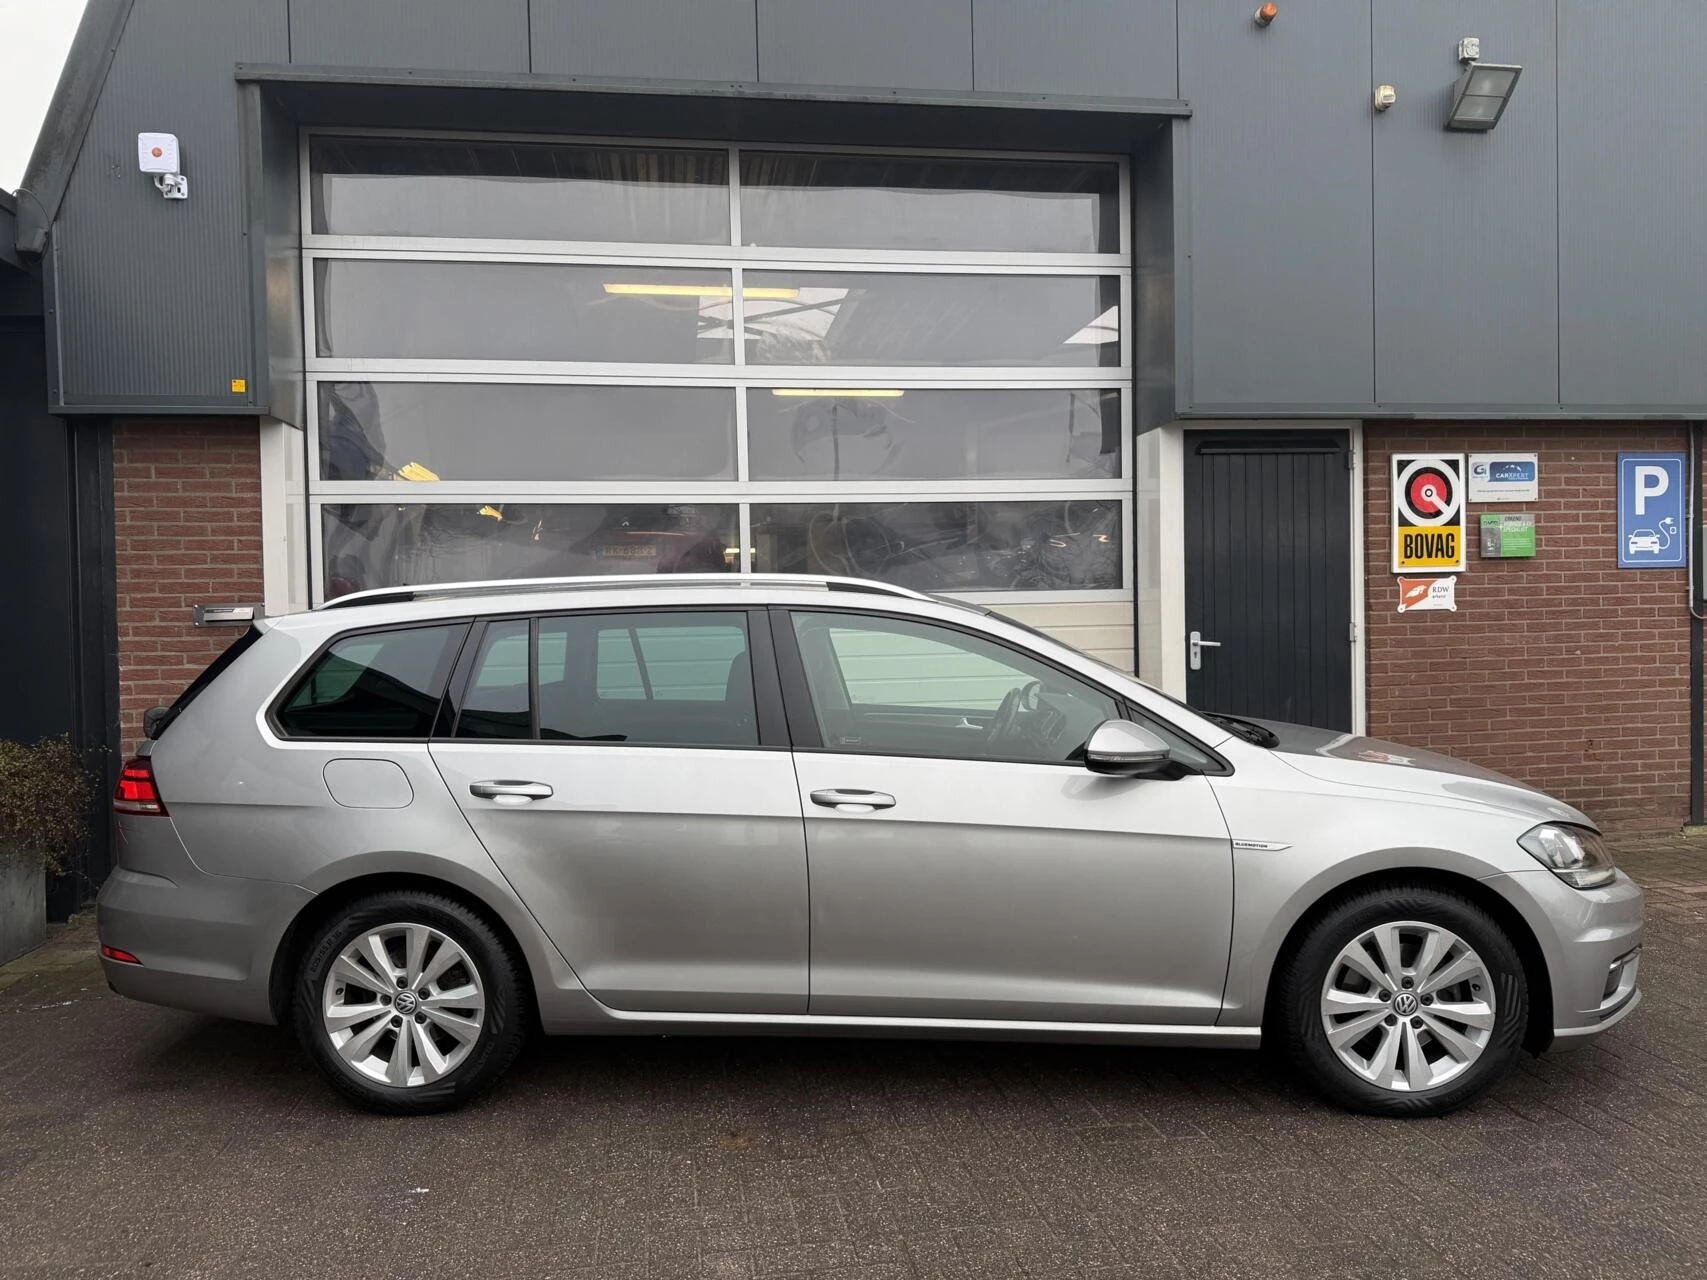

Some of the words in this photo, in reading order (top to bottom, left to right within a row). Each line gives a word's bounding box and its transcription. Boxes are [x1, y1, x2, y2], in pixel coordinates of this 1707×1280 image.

[1635, 465, 1669, 516] P
[1404, 533, 1455, 559] BOVAG
[1432, 585, 1450, 593] RDW
